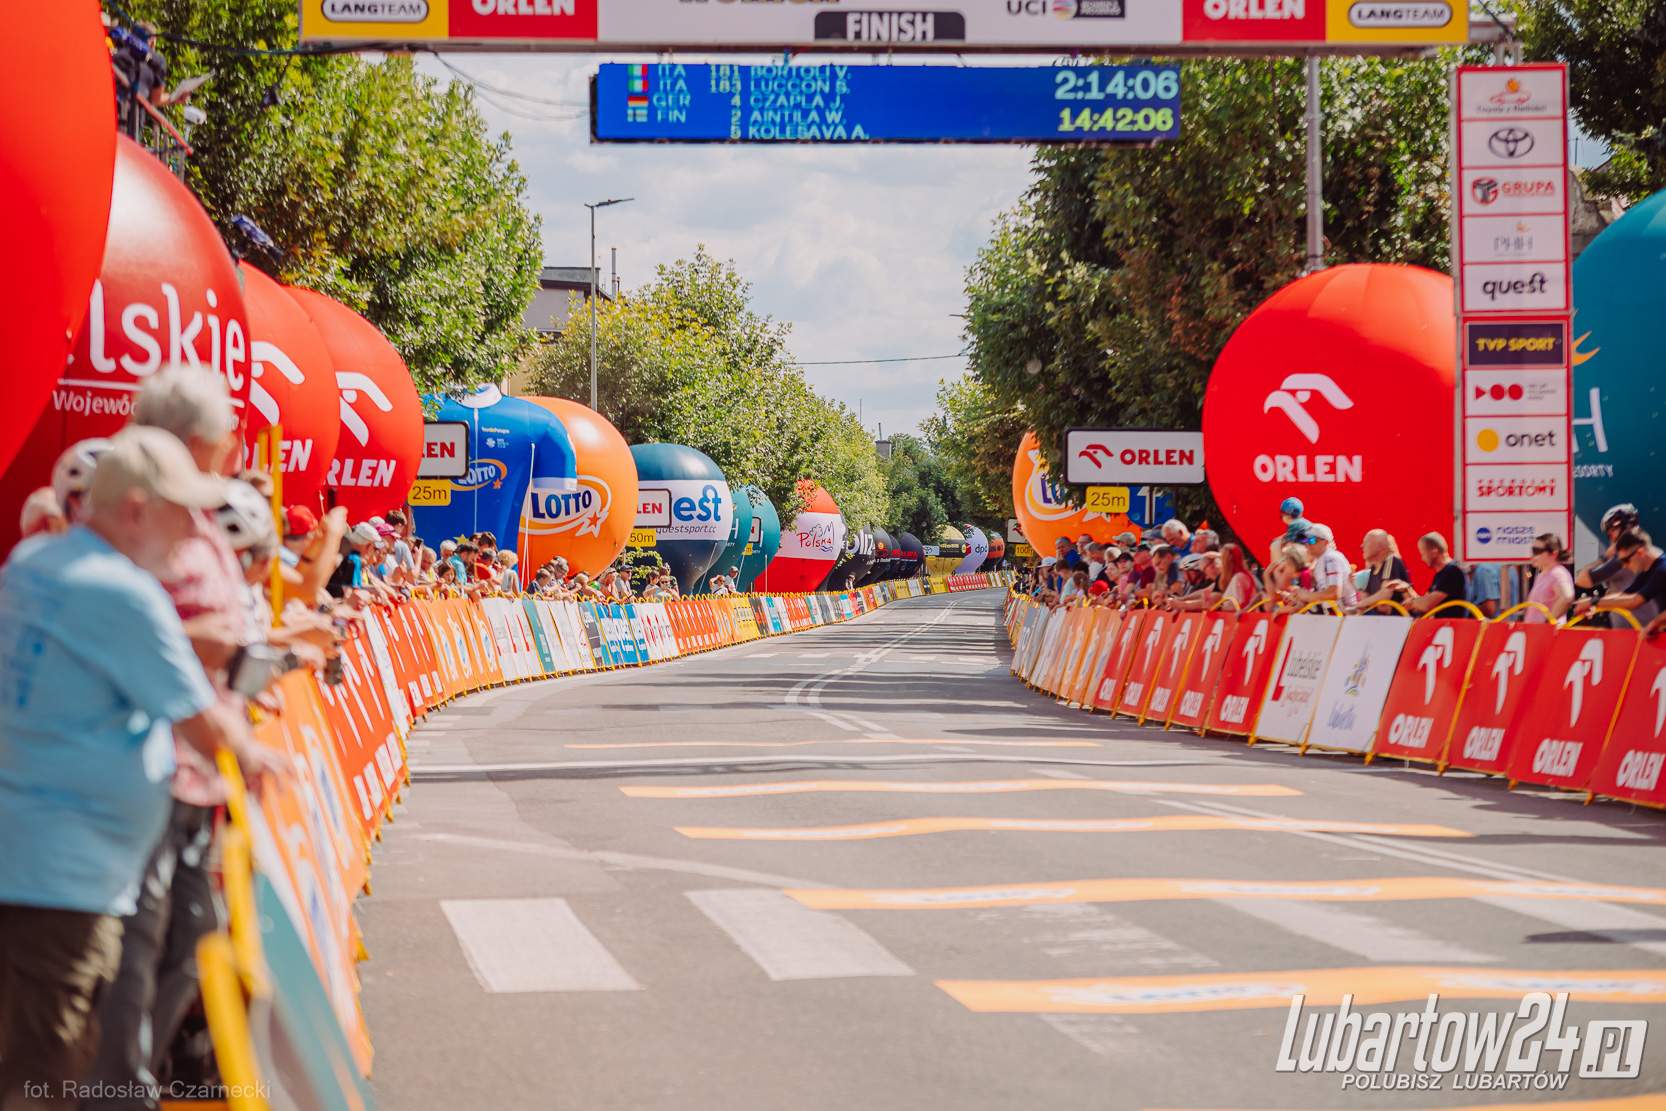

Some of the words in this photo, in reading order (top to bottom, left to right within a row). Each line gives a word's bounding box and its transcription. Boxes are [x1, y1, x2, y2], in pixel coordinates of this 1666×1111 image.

[330, 2, 421, 15] LANGTEAM
[471, 0, 576, 16] ORLEN
[1007, 0, 1046, 16] UCI
[1203, 0, 1306, 20] ORLEN
[1357, 9, 1446, 21] LANGTEAM
[846, 12, 935, 42] FINISH
[1054, 70, 1179, 99] 2:14:06
[1057, 108, 1174, 132] 14:42:06
[1501, 181, 1554, 196] GRUPA
[1481, 272, 1547, 301] quest
[89, 279, 246, 393] lskie
[1475, 337, 1506, 352] TVP
[1508, 336, 1555, 352] SPORT
[1504, 430, 1557, 448] onet
[1120, 448, 1195, 465] ORLEN
[326, 457, 397, 488] RLEN
[1253, 453, 1363, 483] ORLEN
[412, 486, 448, 501] 25m
[1090, 492, 1127, 507] 25m
[531, 490, 592, 519] LOTTO
[629, 533, 654, 543] 50m
